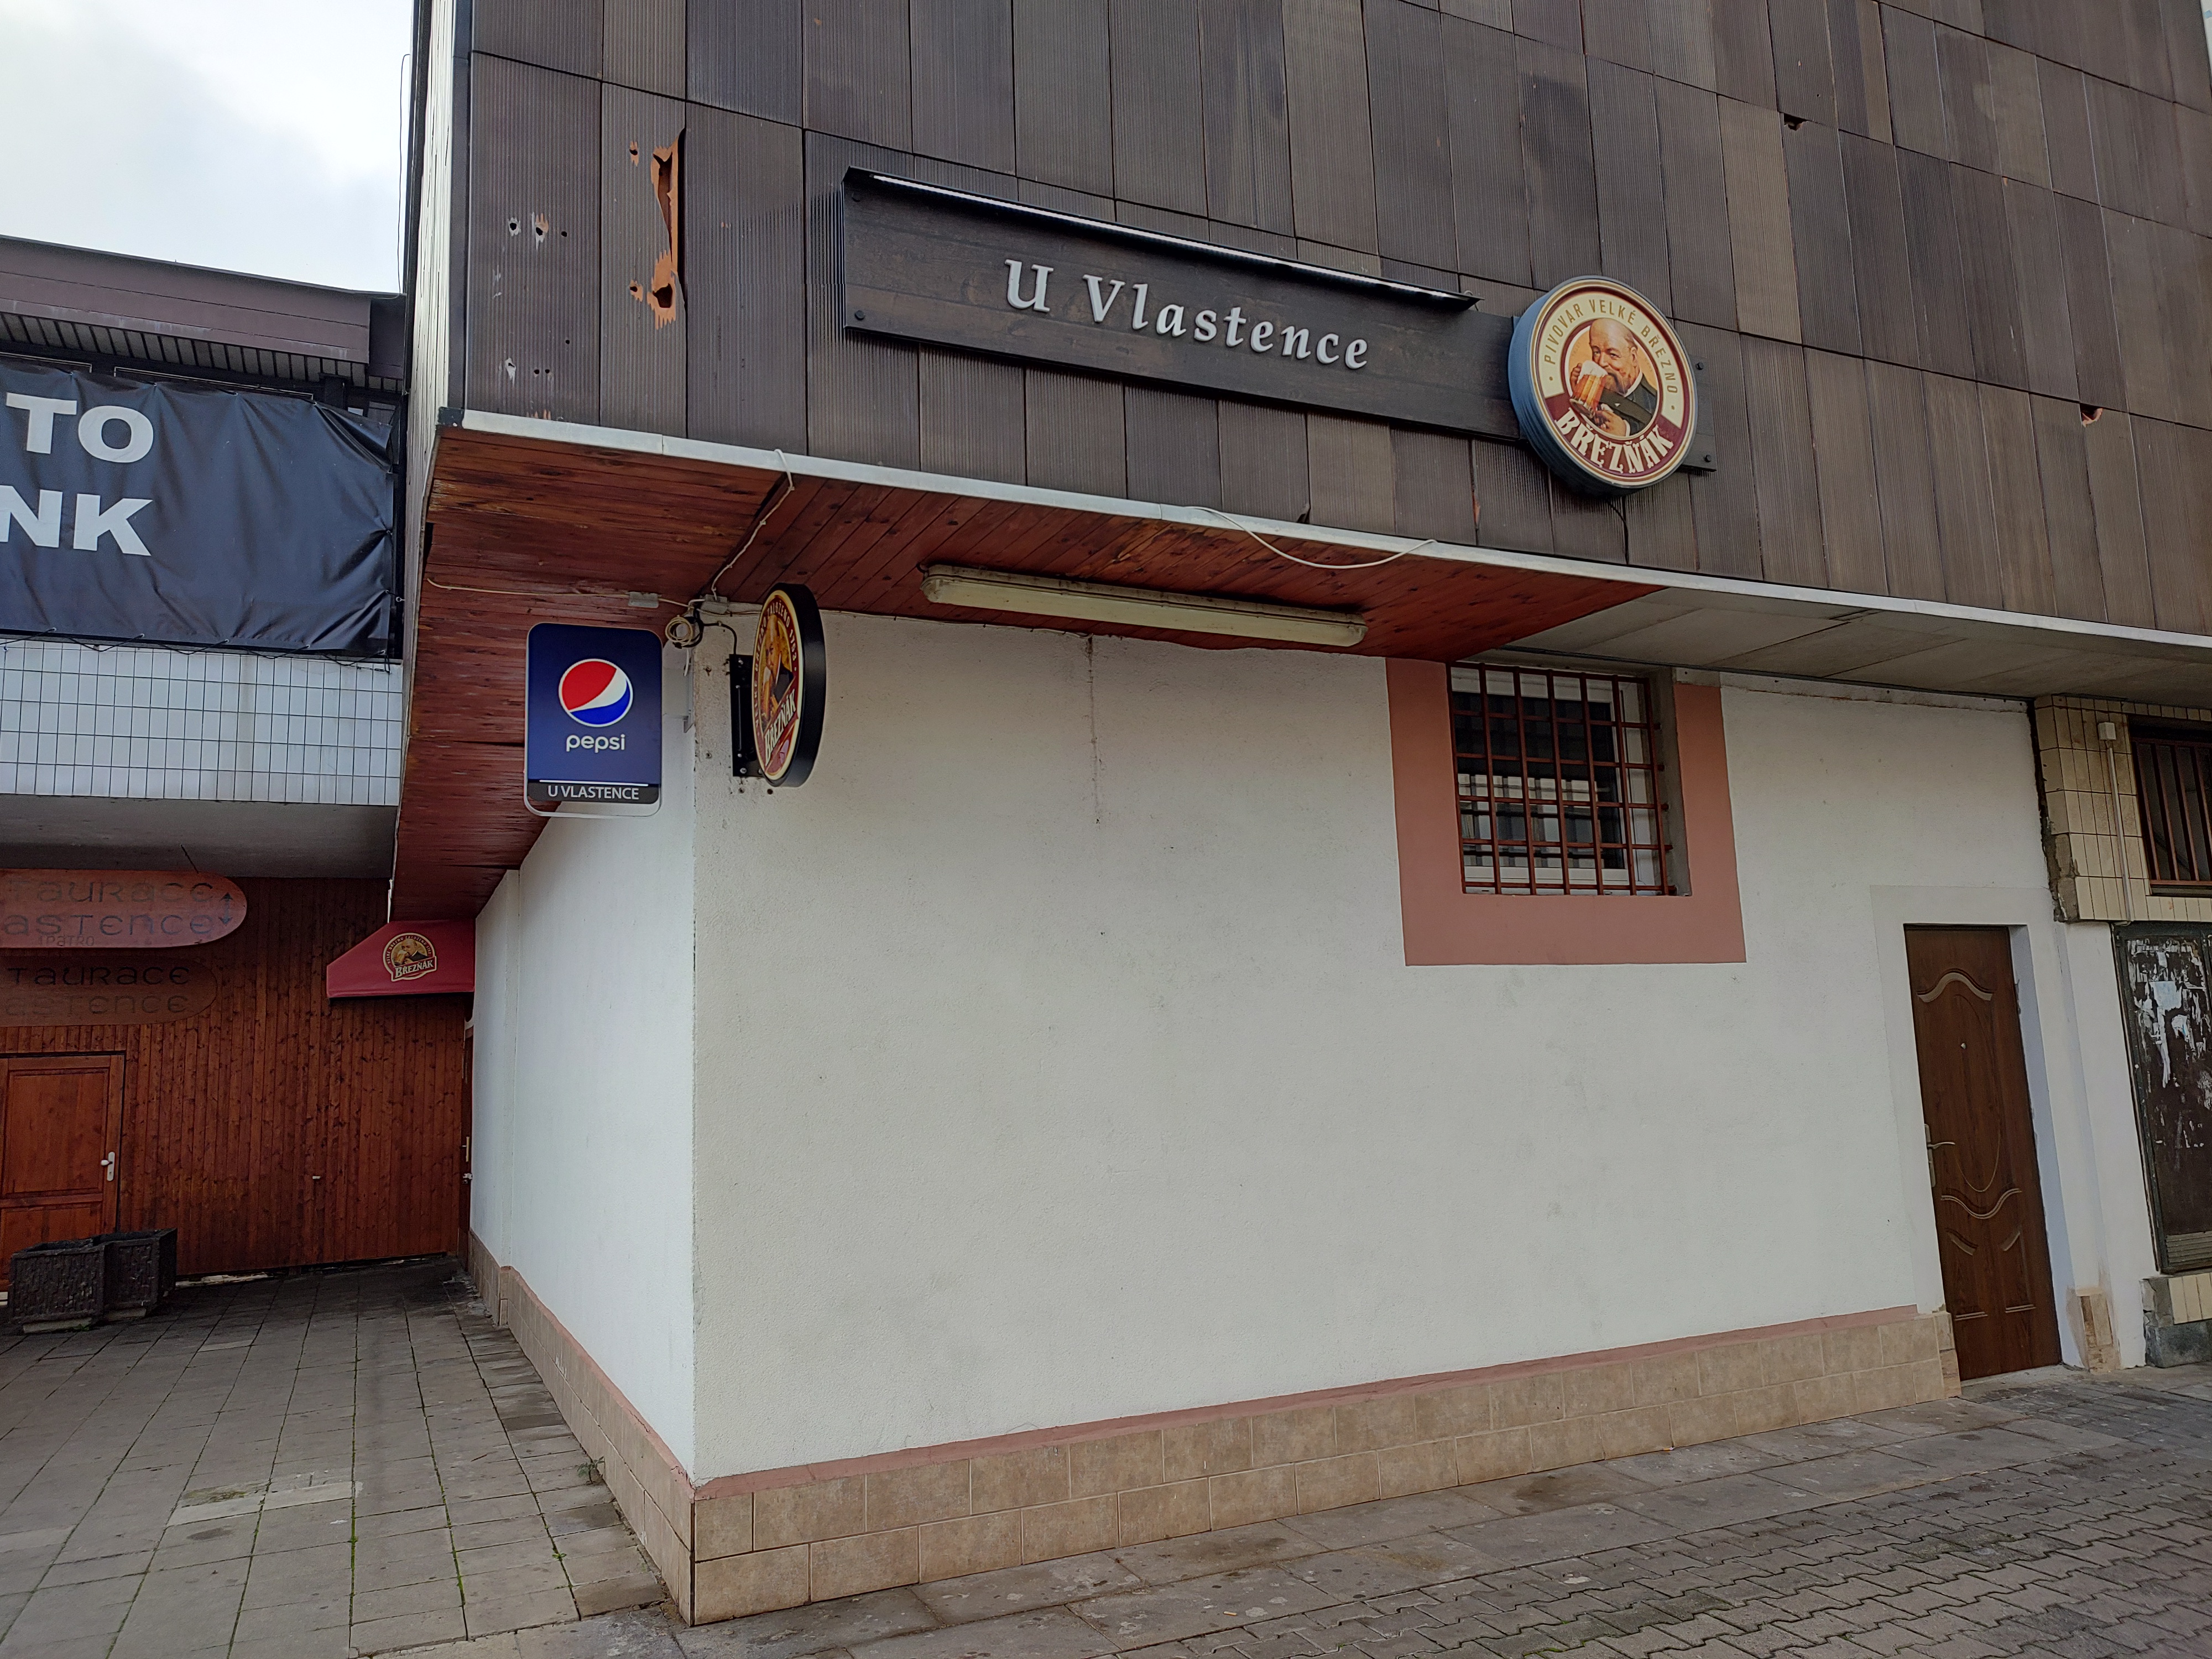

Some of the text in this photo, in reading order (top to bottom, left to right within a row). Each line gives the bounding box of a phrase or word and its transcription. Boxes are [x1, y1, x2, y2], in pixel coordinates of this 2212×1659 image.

[1004, 259, 1369, 370] U Vlastence
[1544, 299, 1678, 394] PIVOVAR VELKÉ BŘEZNO
[6, 392, 154, 463] TO
[1554, 407, 1674, 474] BŘEZNÁK
[566, 733, 626, 753] pepsi
[764, 688, 796, 767] BŘEZNÁK
[547, 785, 639, 800] U VLASTENCE
